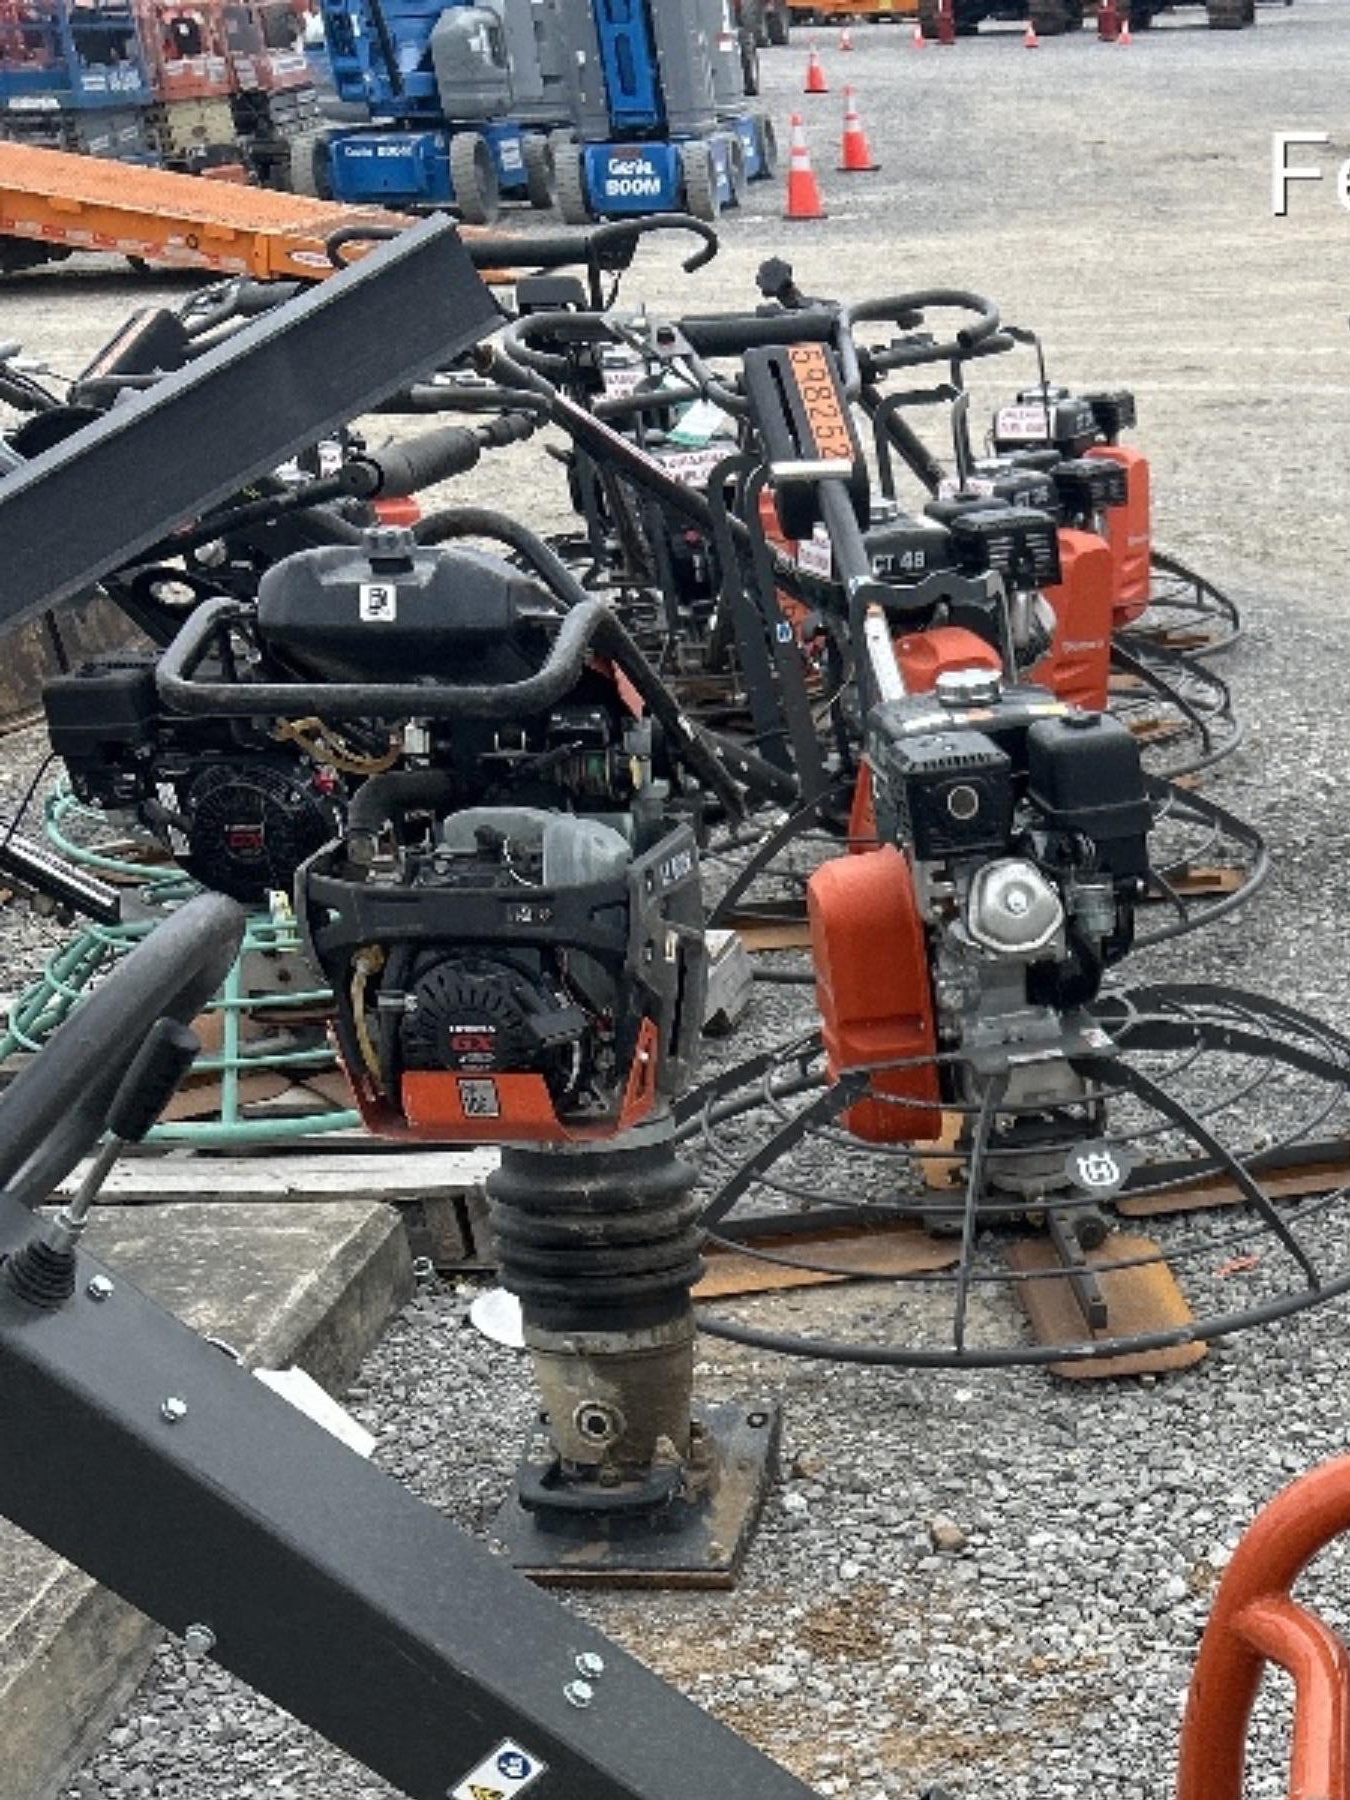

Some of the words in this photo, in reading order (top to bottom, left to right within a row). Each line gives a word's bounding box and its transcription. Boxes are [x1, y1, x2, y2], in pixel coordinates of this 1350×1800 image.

[607, 158, 656, 175] Genie
[605, 177, 661, 196] BOOM
[791, 350, 850, 459] 598252
[450, 1034, 495, 1052] GX
